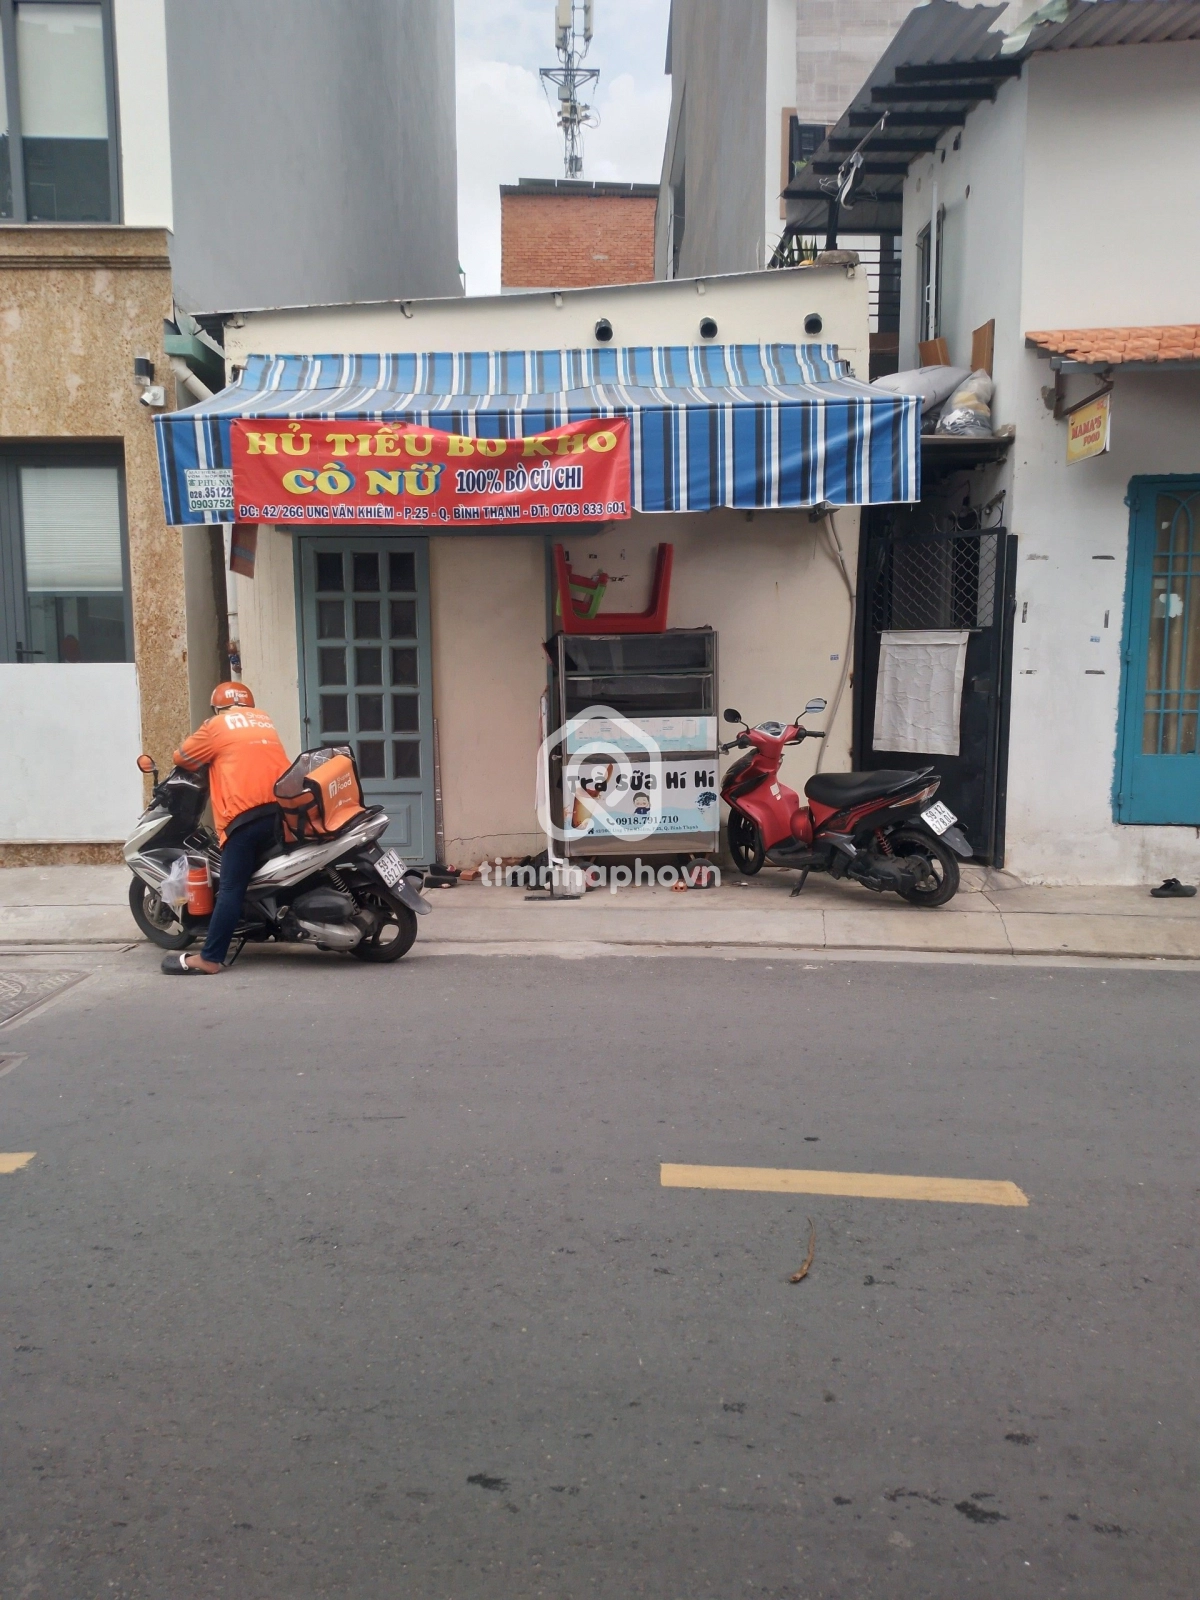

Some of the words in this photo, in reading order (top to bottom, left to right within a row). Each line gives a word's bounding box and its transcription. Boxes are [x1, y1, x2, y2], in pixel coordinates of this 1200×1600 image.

[1071, 416, 1102, 440] MAMA'S
[246, 423, 312, 456] HỦ
[521, 431, 617, 457] KHO
[282, 460, 356, 495] CÔ
[365, 461, 447, 495] NỮ
[455, 468, 502, 493] 100%
[504, 462, 529, 492] BÒ
[529, 460, 552, 491] CỦ
[554, 466, 584, 490] CHI
[190, 487, 233, 498] 028.35122
[239, 504, 259, 517] ĐC:
[262, 504, 304, 518] 42/26G
[306, 505, 329, 518] UNG
[357, 503, 395, 519] KHIÊM
[404, 506, 429, 519] P.25
[453, 504, 480, 520] BÌNH
[483, 505, 520, 521] THẠNH
[530, 504, 549, 517] ĐT:
[552, 503, 580, 516] 0703
[583, 502, 603, 515] 833
[606, 501, 626, 514] 601
[567, 771, 607, 793] Trà
[666, 771, 686, 789] Hí
[694, 770, 715, 788] Hí
[615, 815, 679, 825] 0918.791.710
